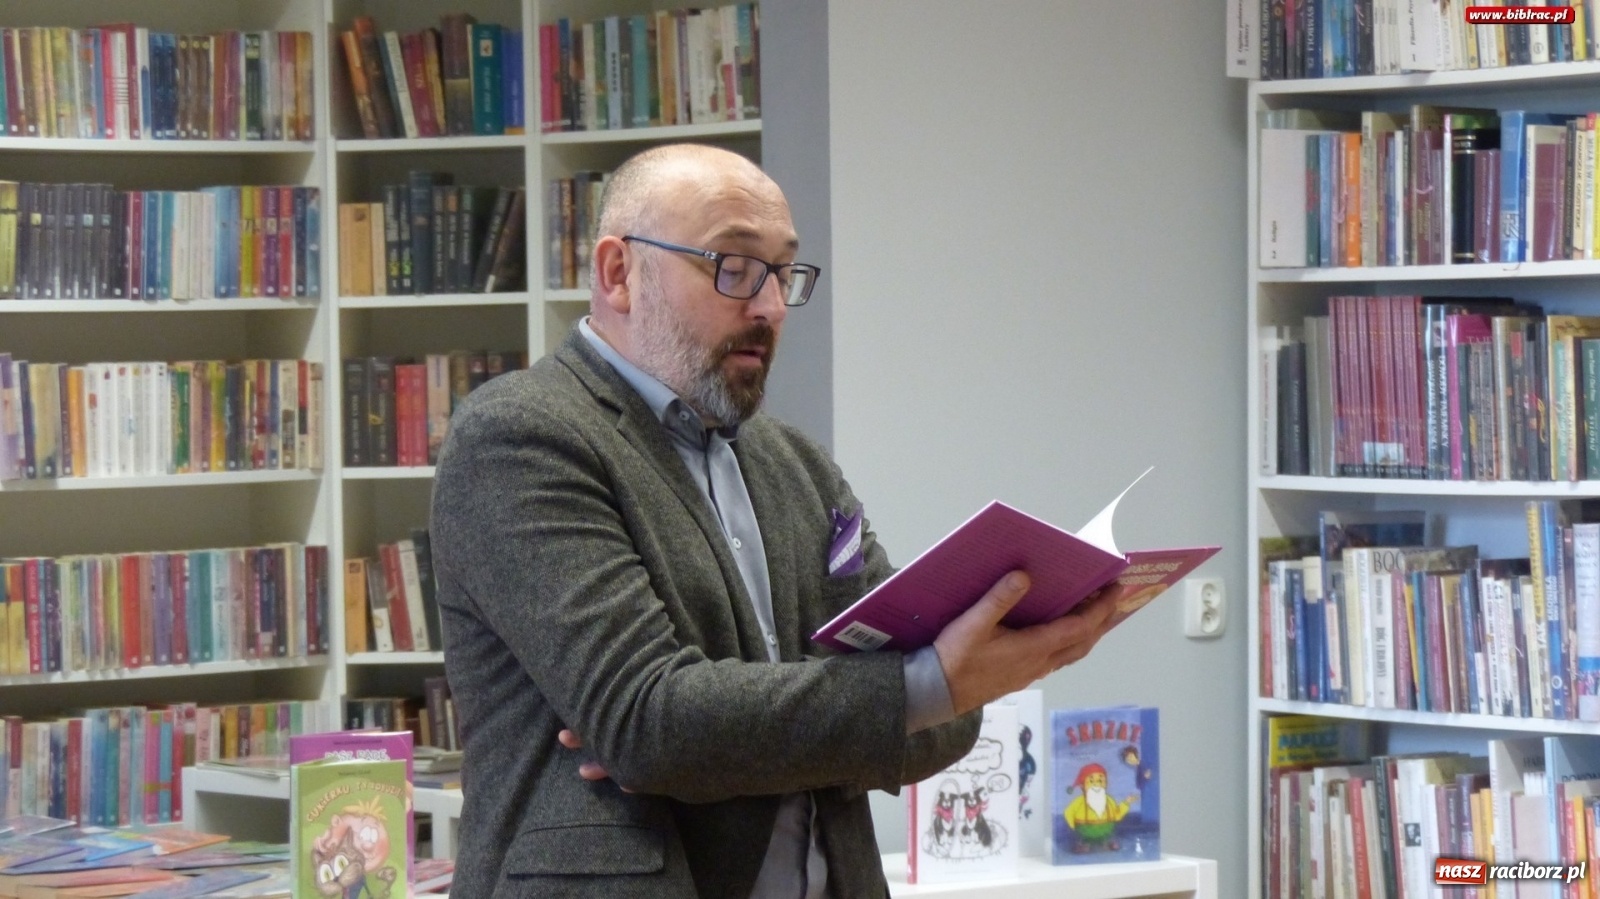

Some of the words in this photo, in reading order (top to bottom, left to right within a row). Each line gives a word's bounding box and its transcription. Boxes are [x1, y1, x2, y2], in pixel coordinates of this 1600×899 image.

[1545, 576, 1554, 621] KRONIKA
[1535, 621, 1547, 650] TAK
[1066, 719, 1143, 746] SKRZAT
